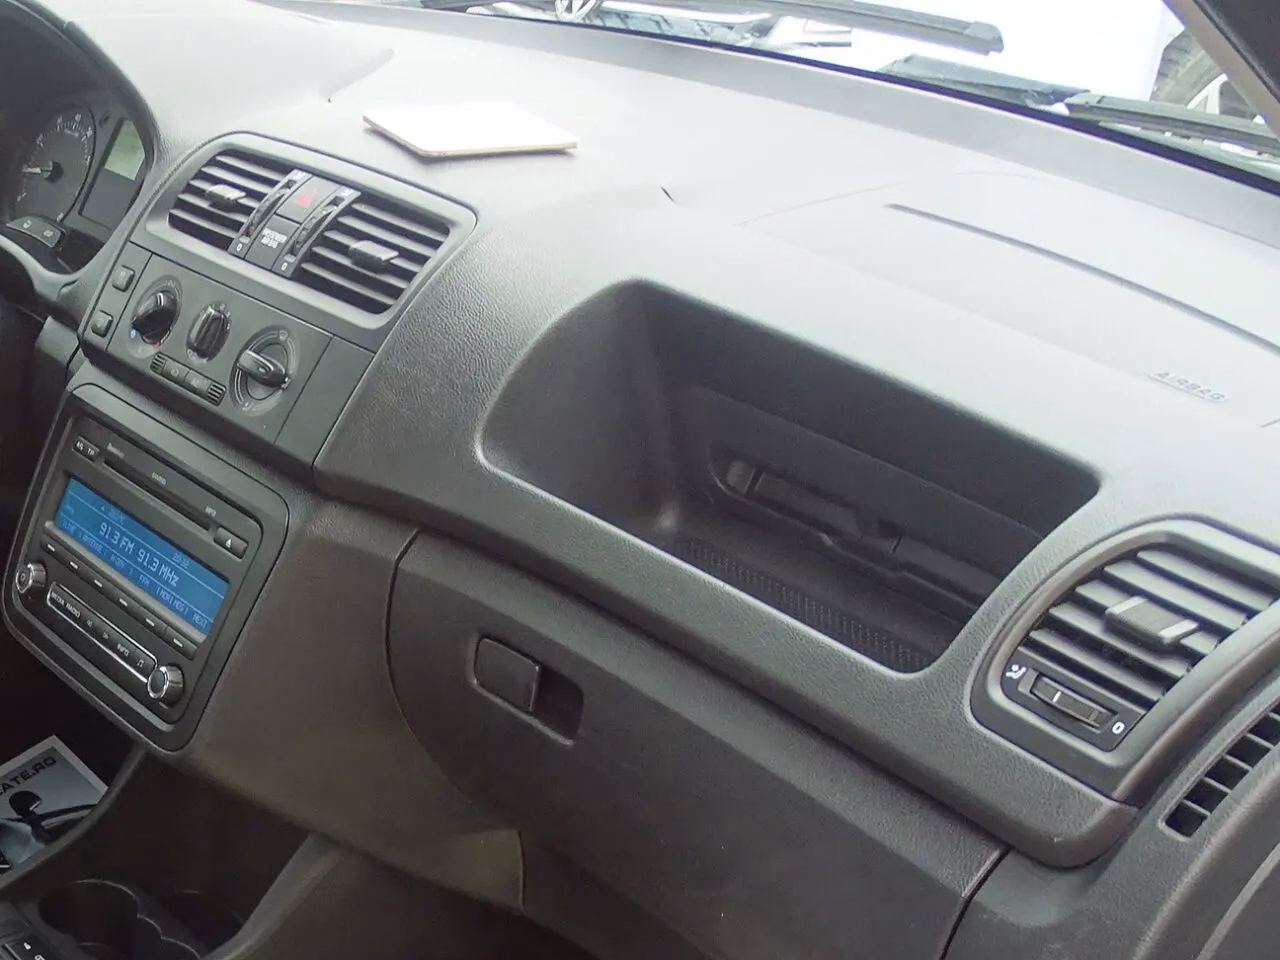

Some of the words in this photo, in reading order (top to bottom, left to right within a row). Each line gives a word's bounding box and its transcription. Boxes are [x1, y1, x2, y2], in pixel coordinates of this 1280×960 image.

[1156, 371, 1226, 402] AIRBAG
[120, 536, 136, 555] FM
[137, 548, 160, 572] 91.3
[158, 563, 180, 587] MHz
